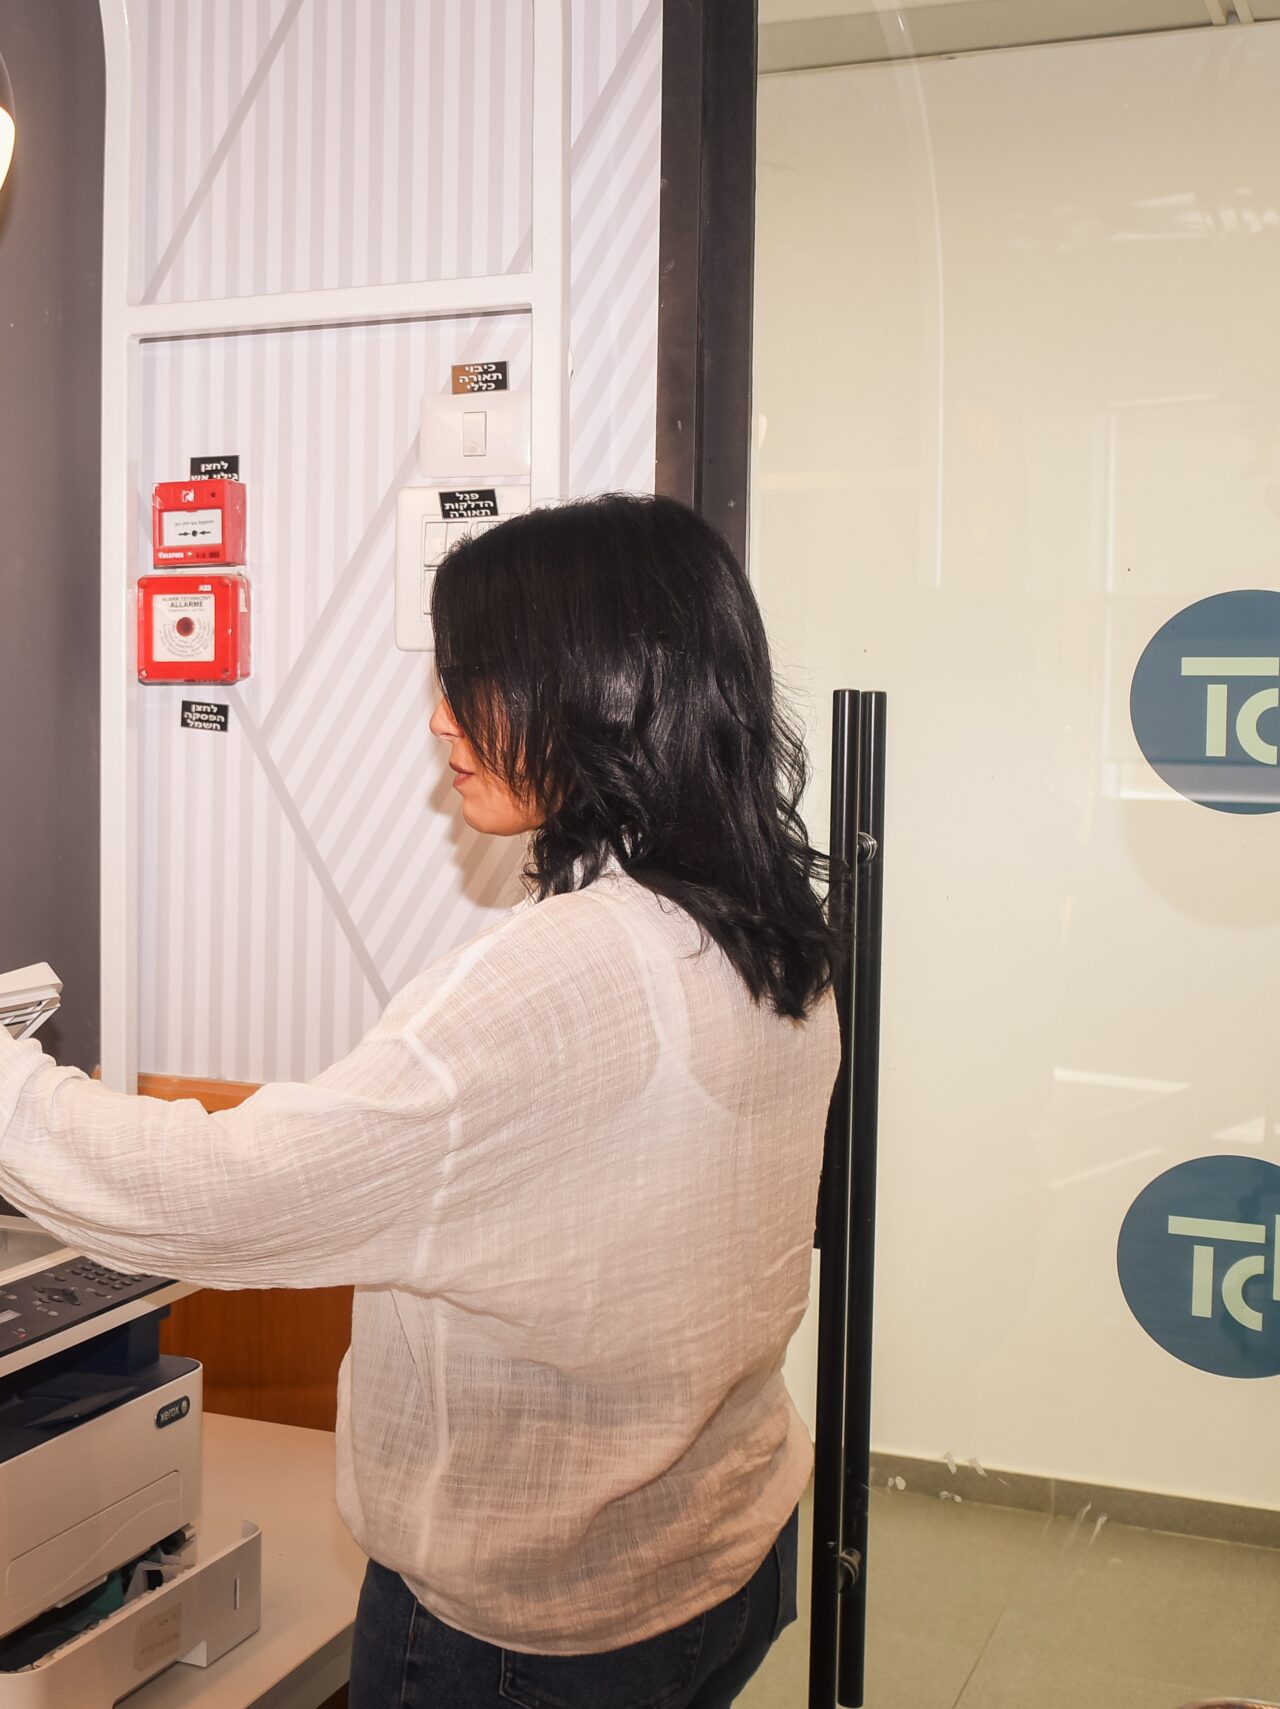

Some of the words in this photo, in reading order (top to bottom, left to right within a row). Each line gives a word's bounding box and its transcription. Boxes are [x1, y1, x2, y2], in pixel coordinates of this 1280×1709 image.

[465, 364, 496, 373] כיבוי
[459, 373, 503, 383] תאורה
[467, 382, 496, 391] כללי
[200, 461, 228, 472] לחצן
[455, 492, 480, 501] פנל
[444, 500, 494, 511] הדלקות
[450, 509, 491, 518] תאורה
[191, 704, 218, 713] לחצן
[184, 711, 225, 722] הפסקה
[187, 719, 221, 730] חשמל
[160, 1405, 180, 1422] xerox
